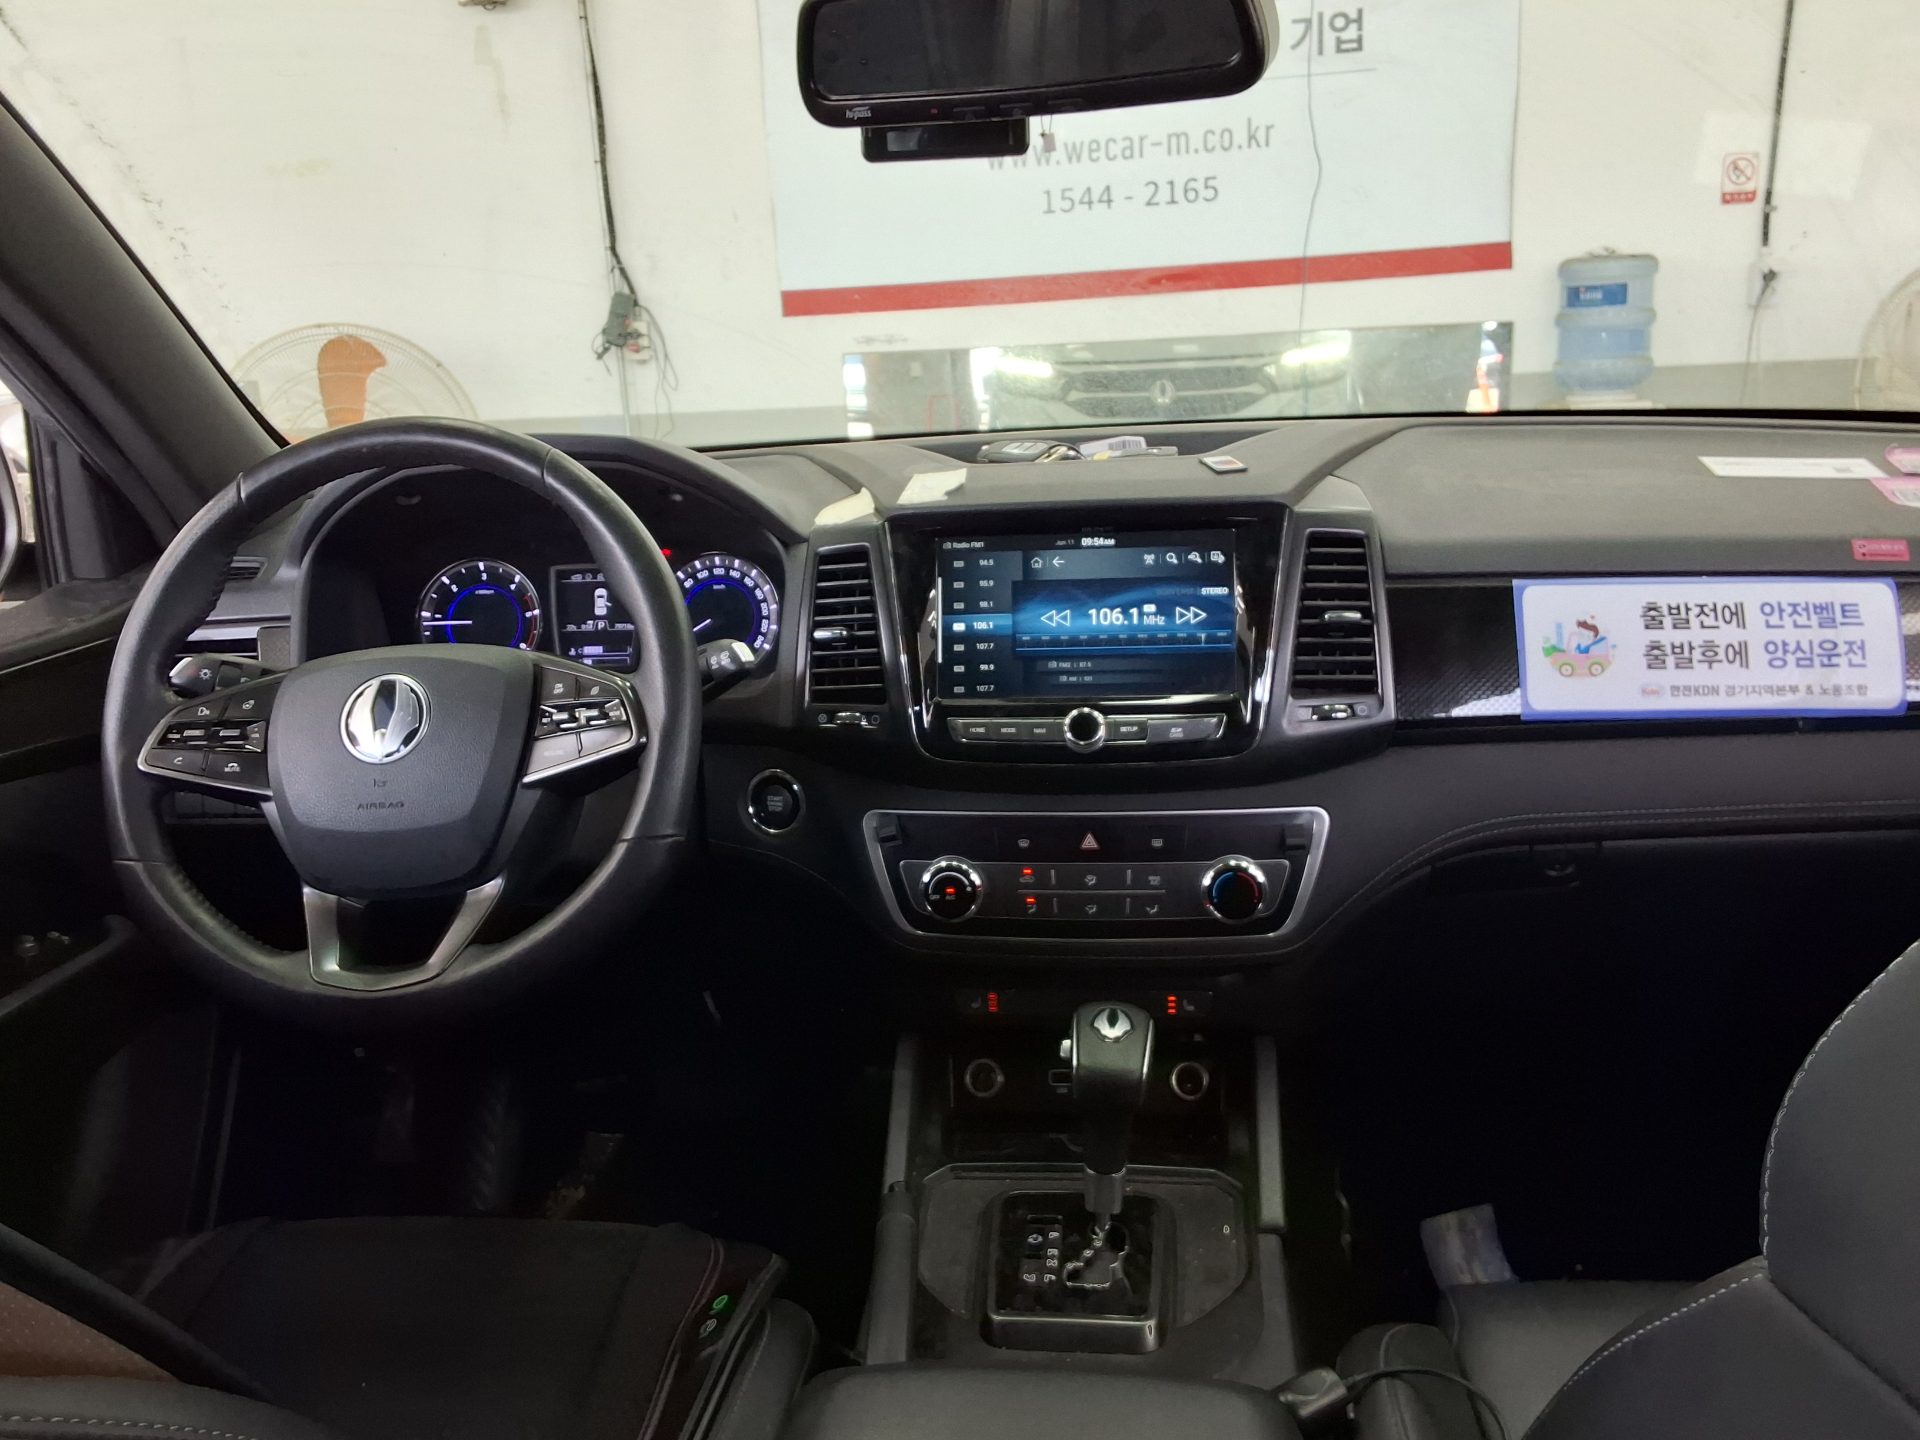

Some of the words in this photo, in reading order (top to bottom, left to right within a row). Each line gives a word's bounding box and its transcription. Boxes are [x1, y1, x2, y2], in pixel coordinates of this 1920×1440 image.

[1289, 7, 1363, 56] 기업
[1042, 184, 1114, 214] 1544
[1144, 176, 1219, 206] 2165
[1201, 586, 1229, 595] STEREO
[1088, 606, 1139, 625] 106.1
[1143, 614, 1166, 625] MHz
[1639, 602, 1747, 631] 출발전에
[1759, 601, 1865, 630] 안전벨트
[973, 621, 993, 630] 106.1
[976, 642, 994, 650] 107.7
[1642, 640, 1750, 670] 출발후에
[1763, 639, 1868, 670] 양심운전
[980, 663, 994, 671] 99.9
[976, 684, 994, 692] 107.7
[357, 801, 405, 811] AIRBAG
